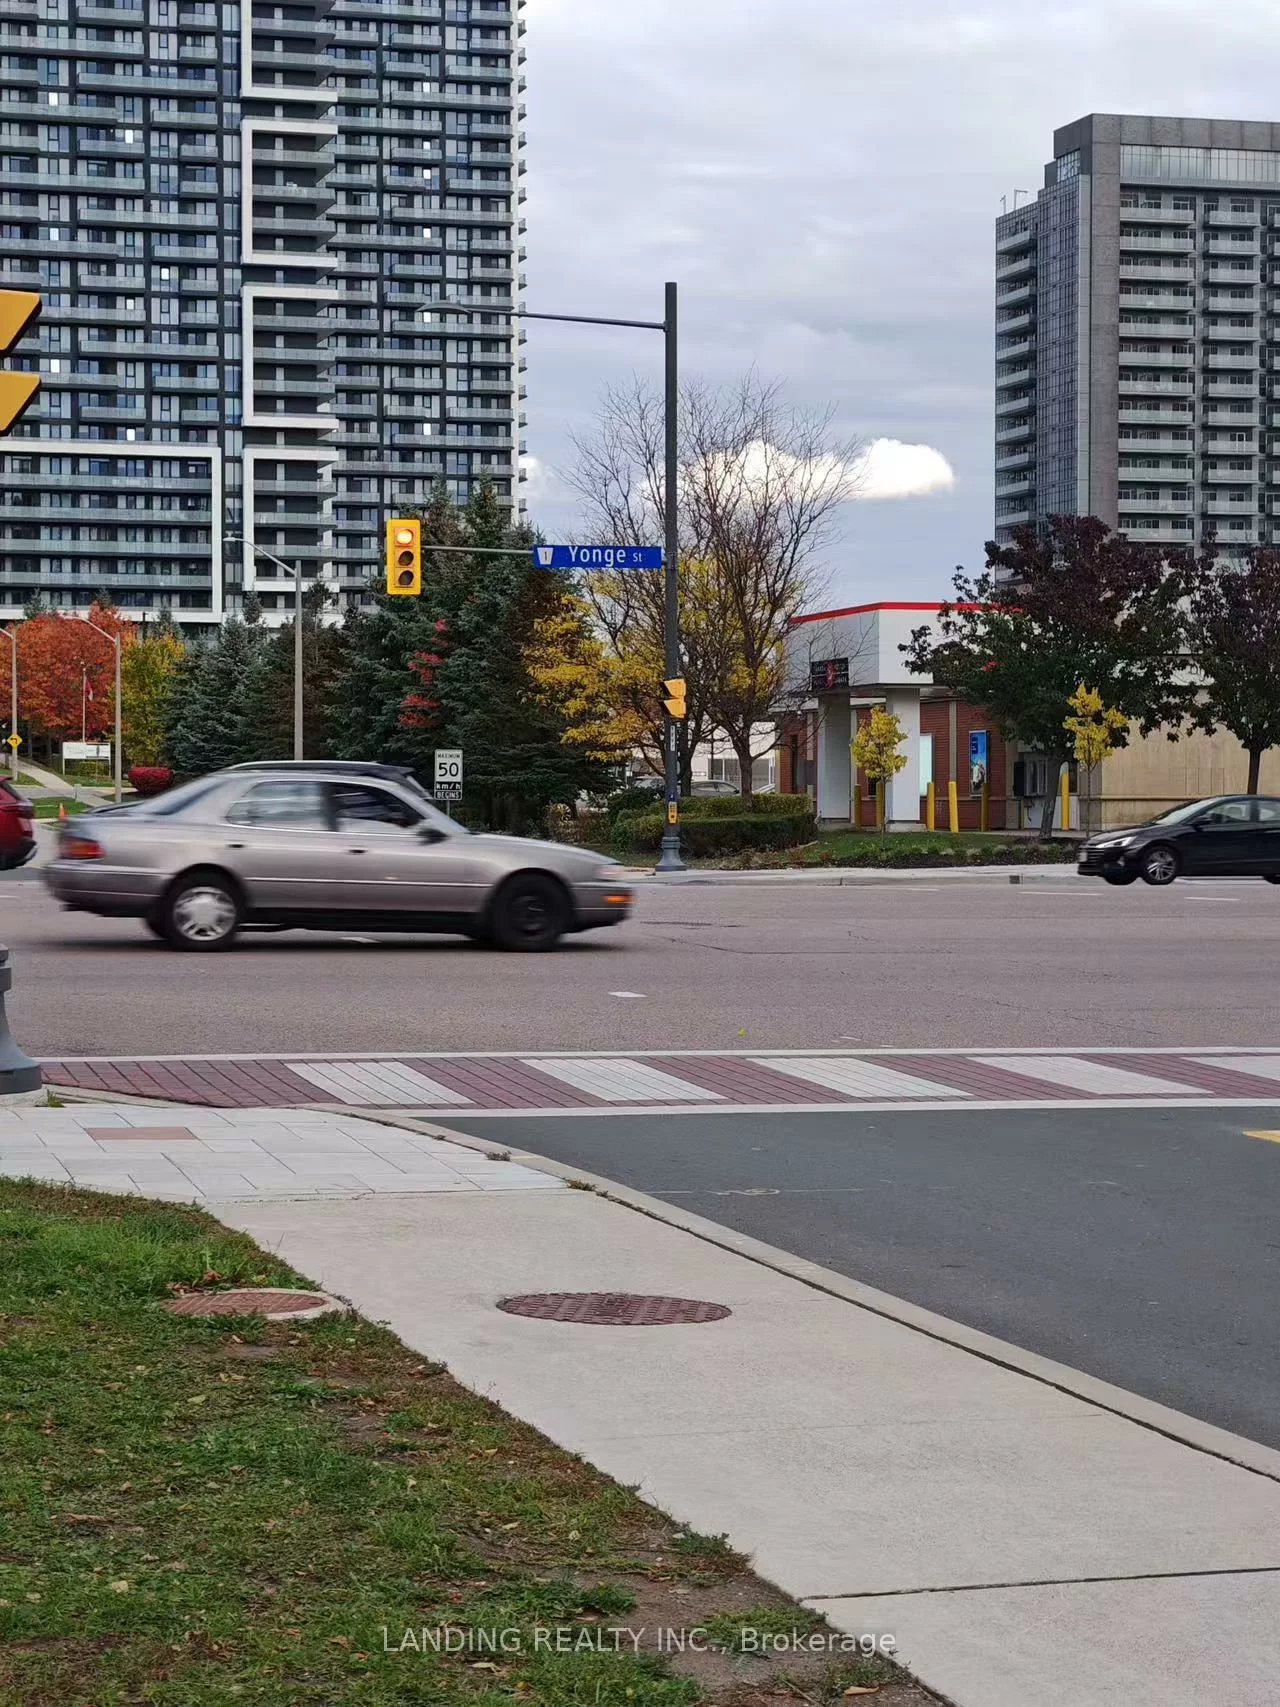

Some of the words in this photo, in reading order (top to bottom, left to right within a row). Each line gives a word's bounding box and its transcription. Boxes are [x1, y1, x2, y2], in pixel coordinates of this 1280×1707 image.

[568, 546, 627, 567] Yonge
[632, 552, 643, 562] St
[438, 762, 459, 777] 50
[436, 782, 461, 790] km/h
[436, 791, 460, 799] BEGINS
